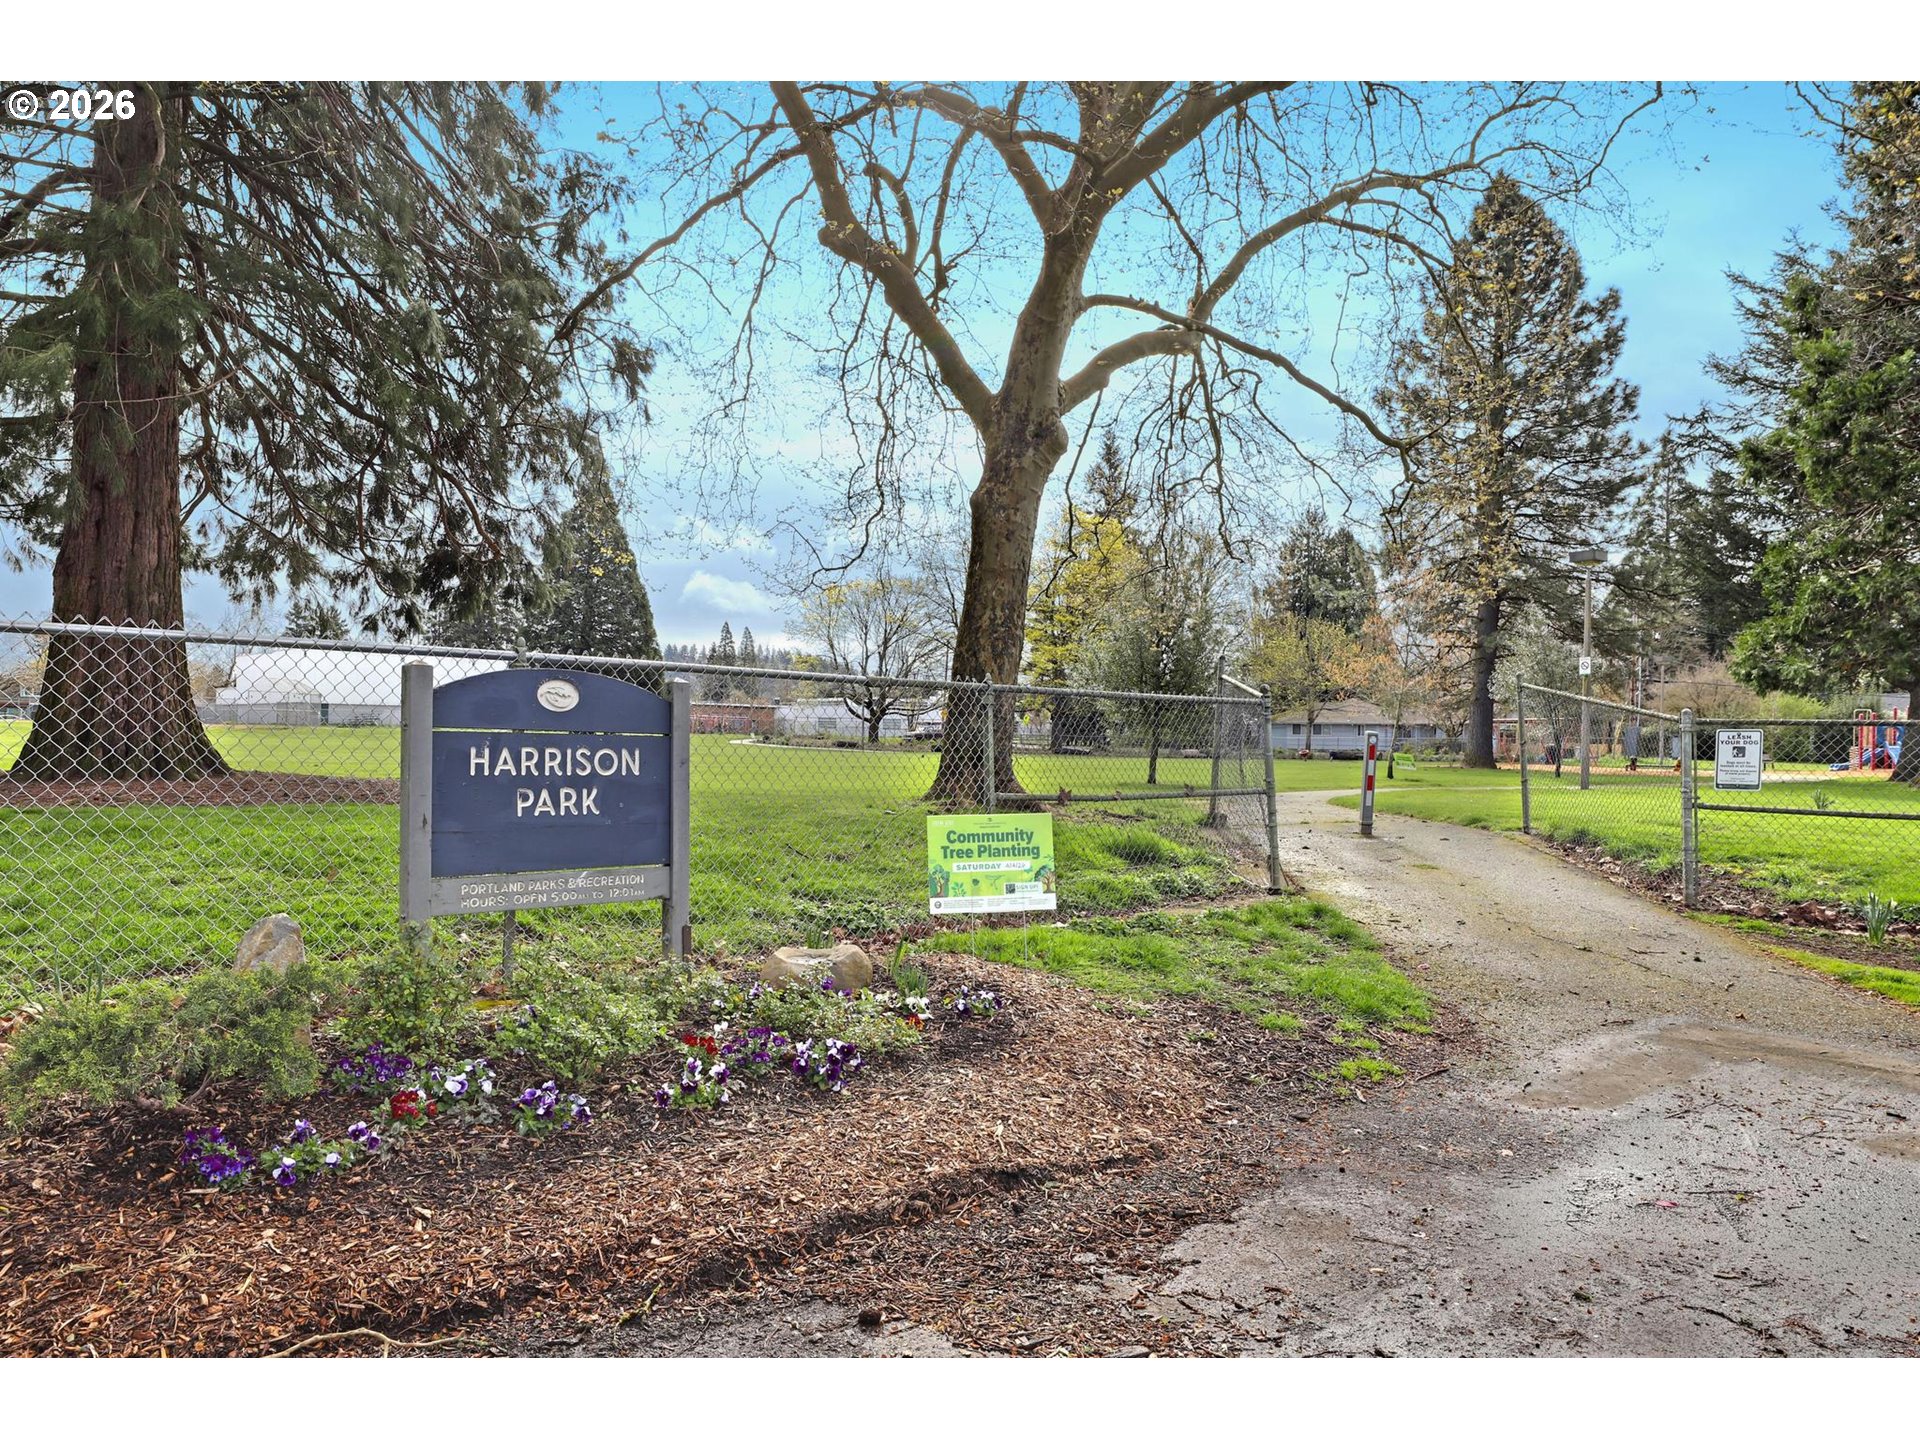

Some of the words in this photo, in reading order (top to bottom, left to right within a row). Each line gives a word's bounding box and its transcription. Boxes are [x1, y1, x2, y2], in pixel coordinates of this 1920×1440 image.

[469, 747, 640, 776] HARRISON
[516, 787, 600, 817] PARK
[946, 828, 1034, 844] Community
[941, 846, 974, 859] Tree
[977, 843, 1041, 859] Planting
[956, 863, 1002, 871] SATURDAY
[461, 881, 525, 896] PORTLAND
[528, 878, 565, 891] PARKS
[579, 874, 645, 888] RECREATION
[461, 895, 509, 908] HOURS:
[514, 892, 547, 905] OPEN
